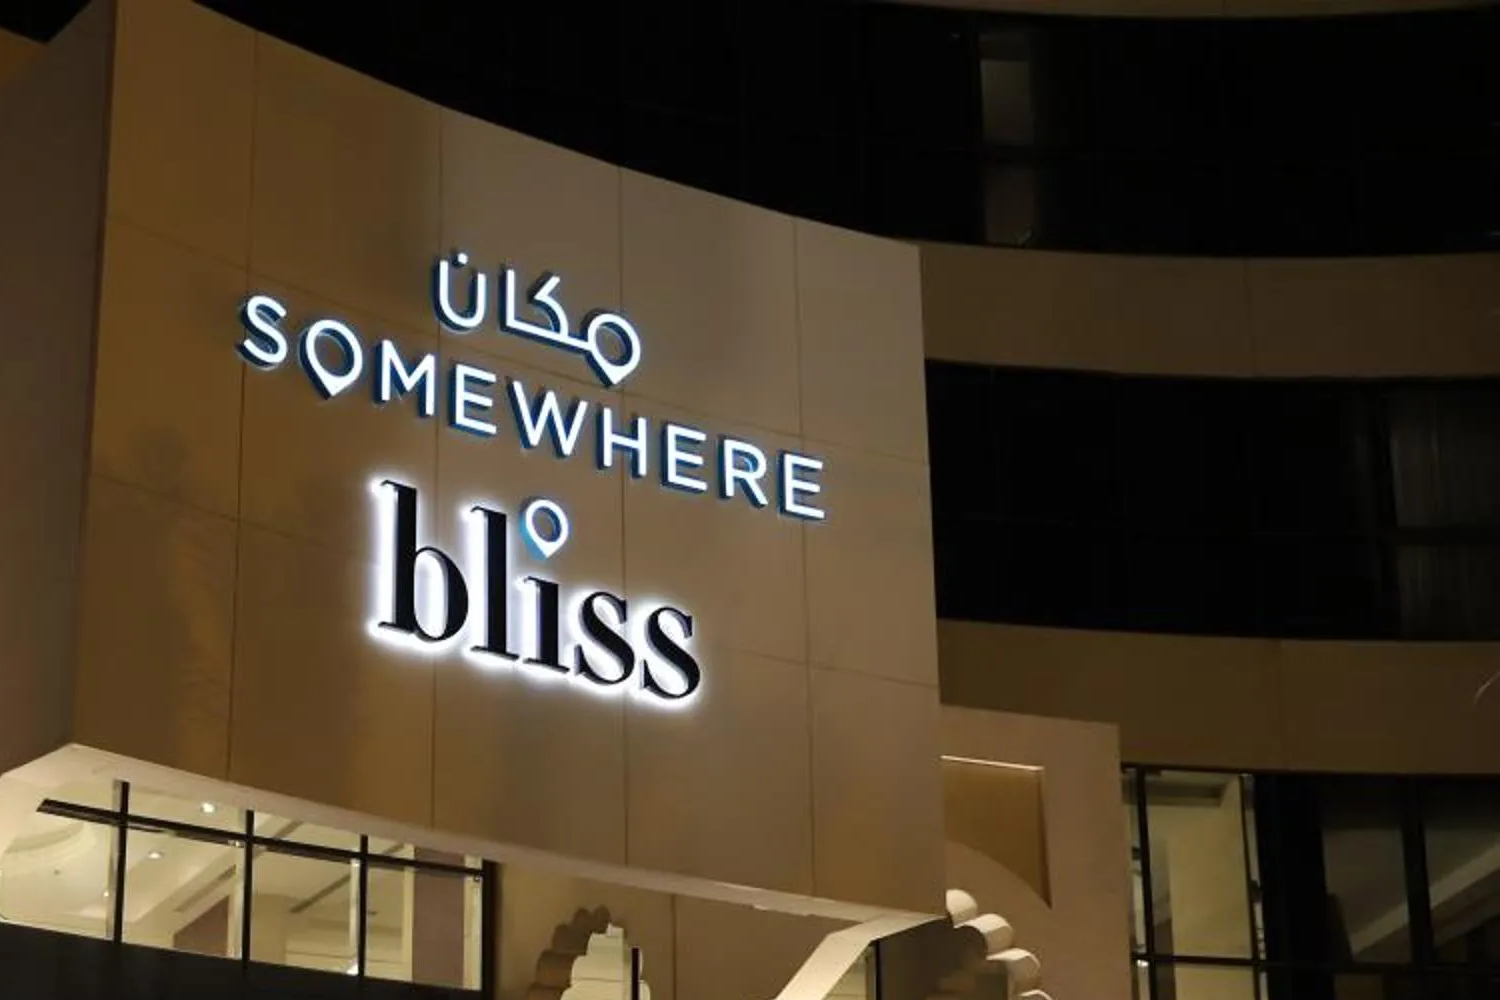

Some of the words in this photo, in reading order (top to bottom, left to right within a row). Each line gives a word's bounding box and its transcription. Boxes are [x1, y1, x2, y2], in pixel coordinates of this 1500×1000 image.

[239, 295, 827, 521] SOMEWHERE
[436, 252, 641, 386] مكان
[376, 478, 702, 702] bliss
